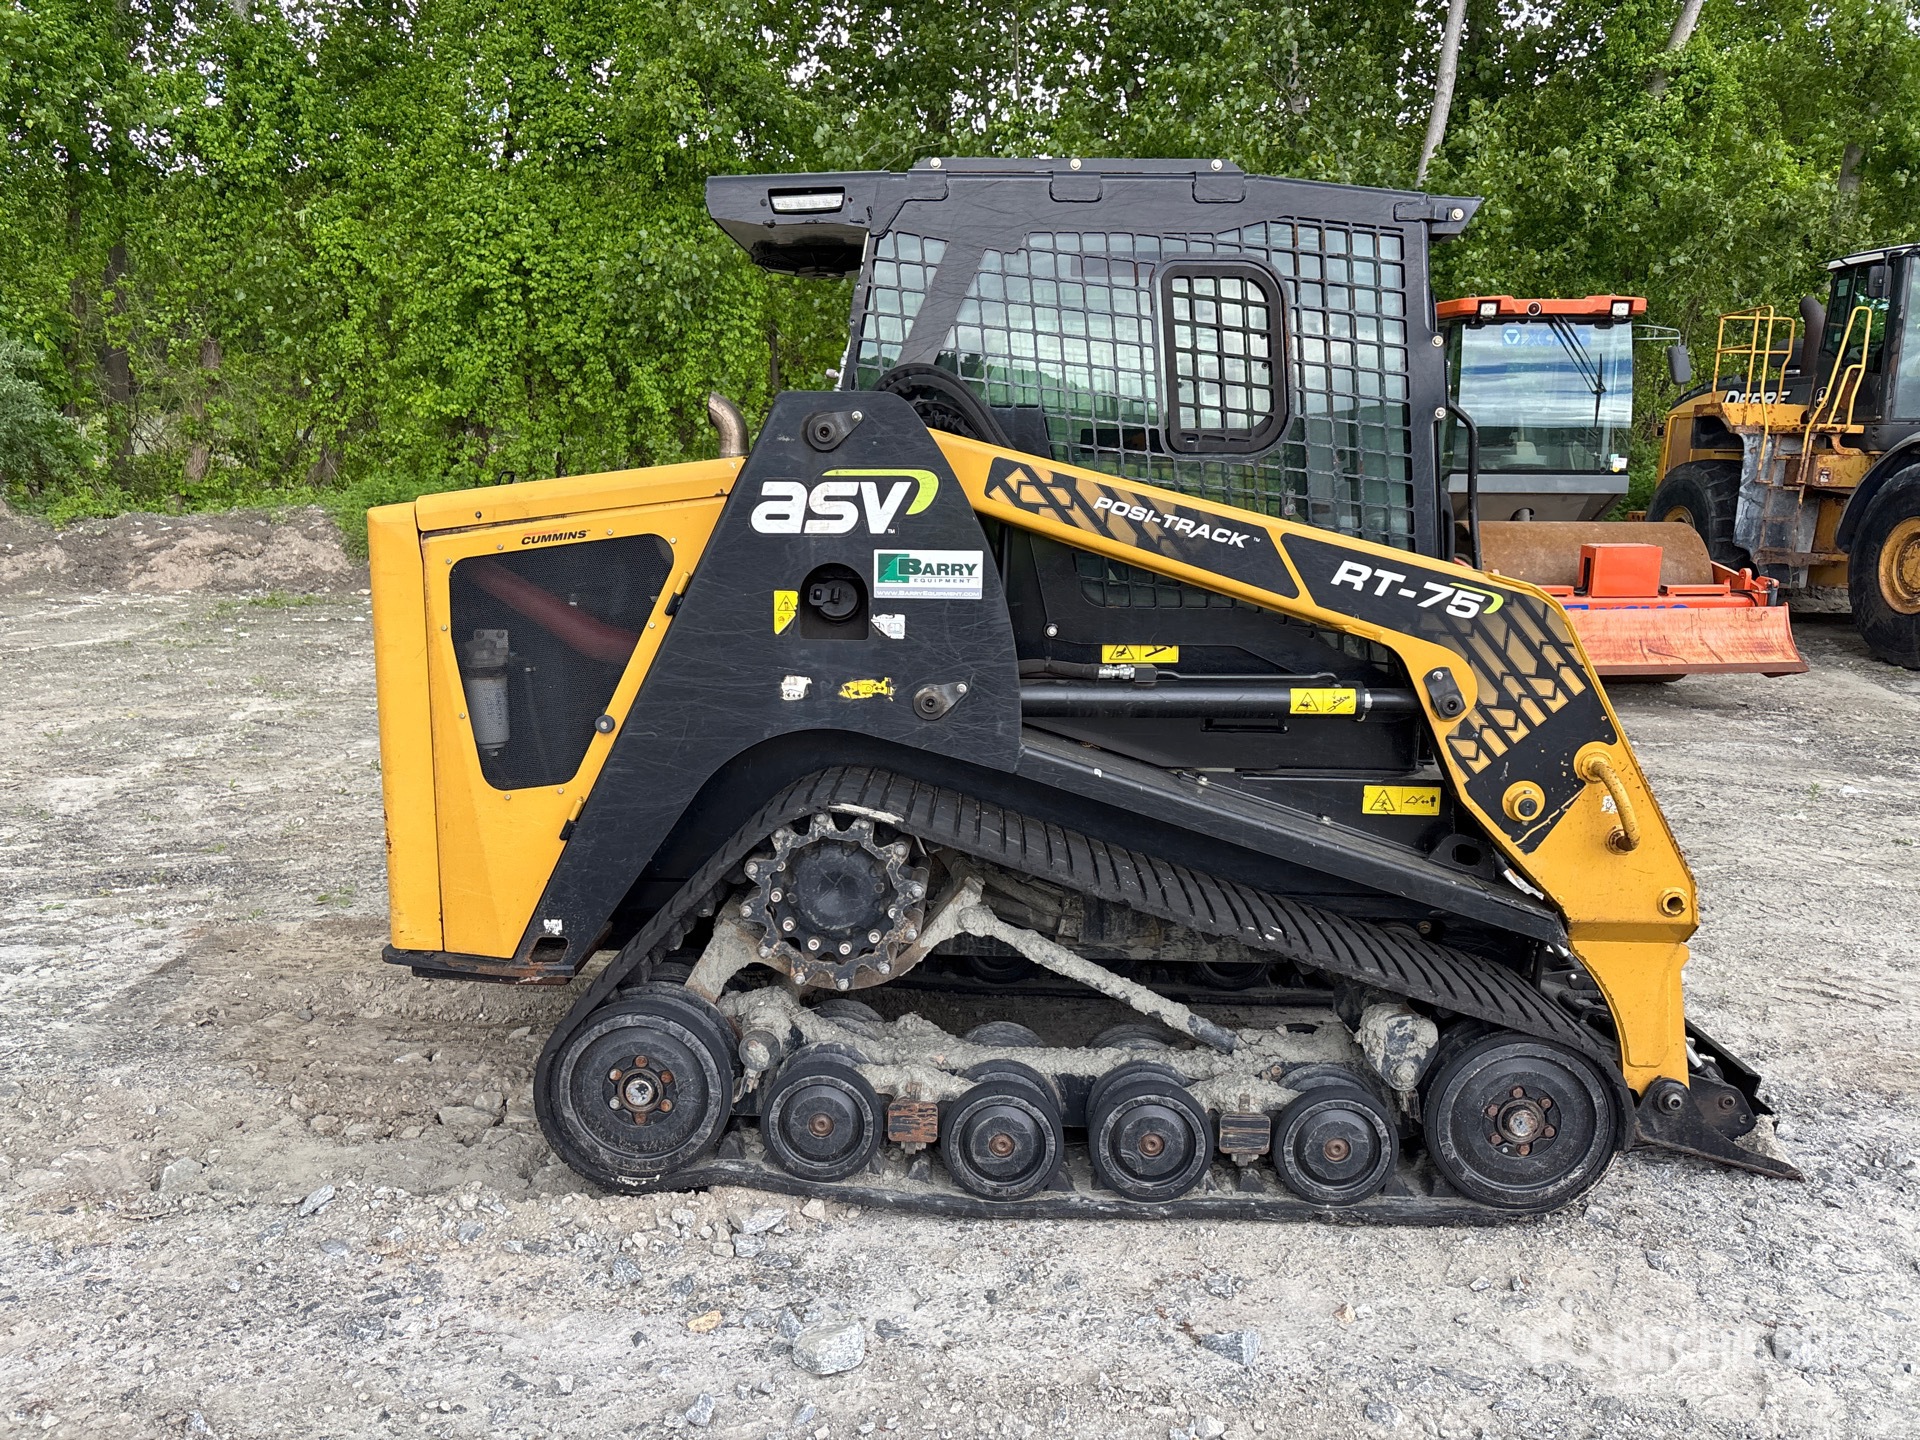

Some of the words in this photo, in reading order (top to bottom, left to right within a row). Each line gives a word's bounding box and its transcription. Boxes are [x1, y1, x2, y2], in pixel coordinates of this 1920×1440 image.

[521, 530, 587, 545] CUMMINS
[1093, 496, 1250, 549] POSI-TRACK
[898, 558, 977, 576] BARRY
[1330, 560, 1486, 619] RT-75
